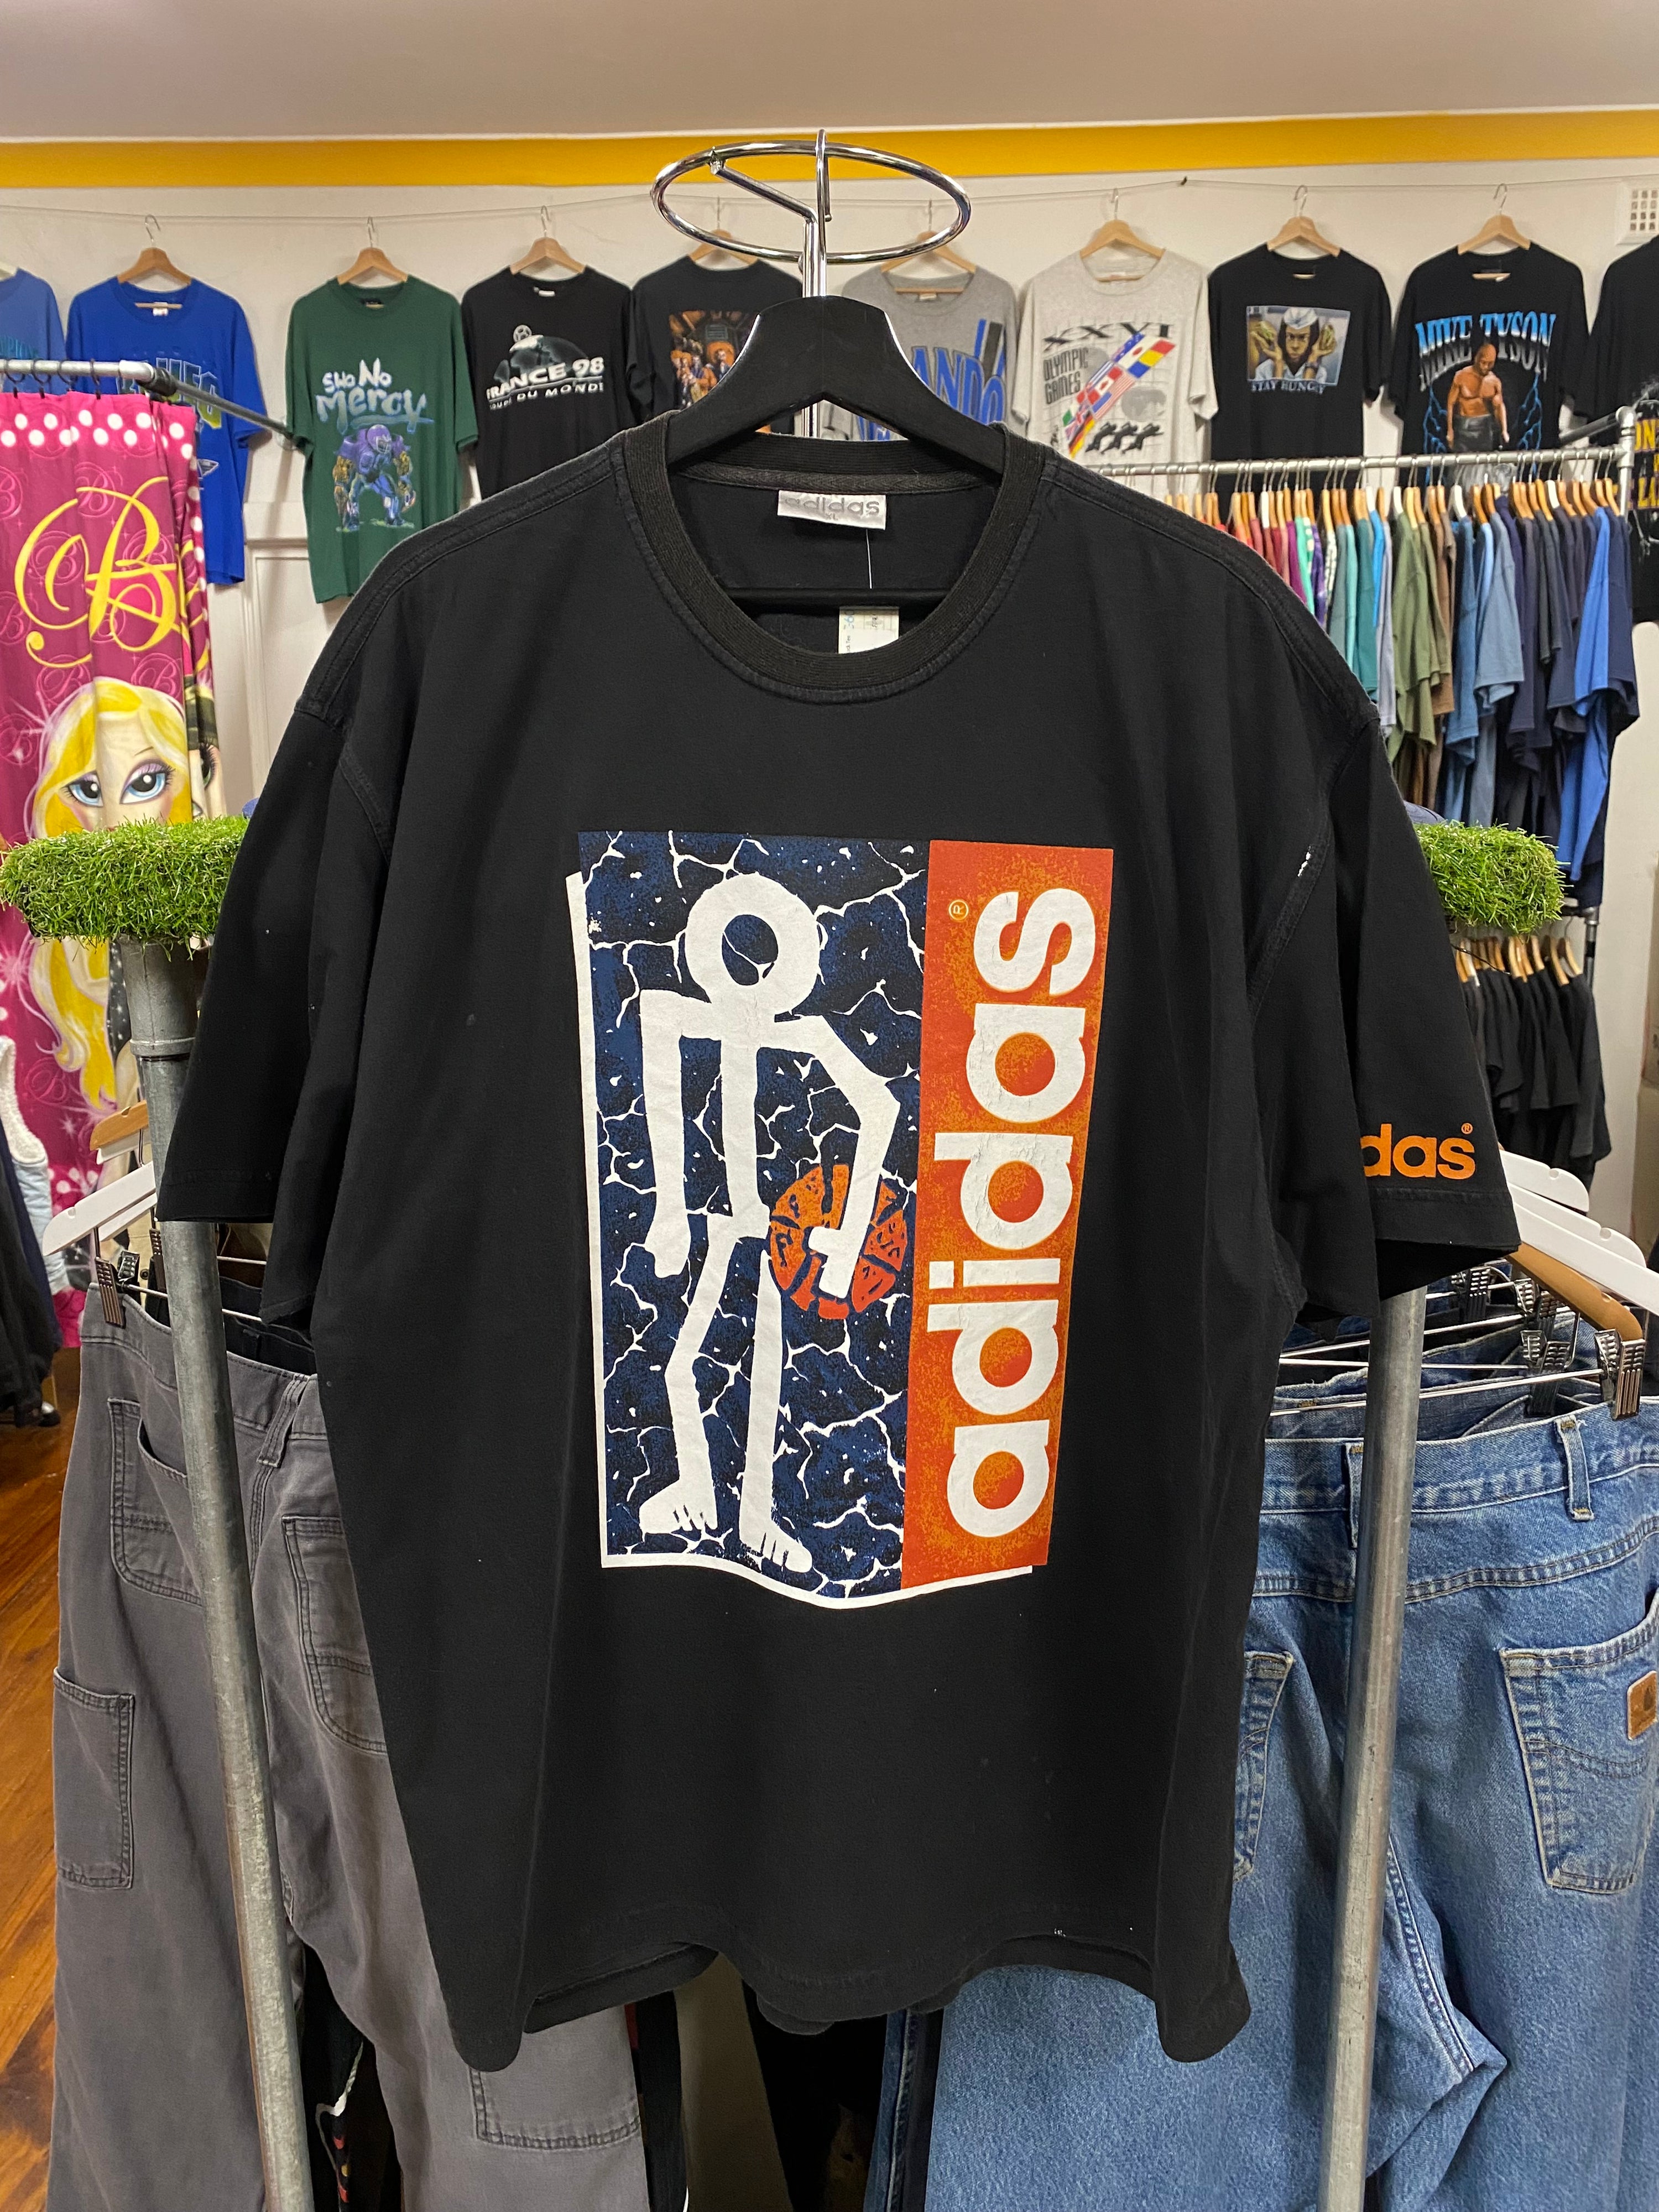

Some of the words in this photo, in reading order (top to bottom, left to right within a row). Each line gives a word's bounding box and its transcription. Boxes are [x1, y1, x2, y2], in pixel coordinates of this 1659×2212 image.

[1479, 311, 1557, 347] TYSON
[572, 357, 604, 378] 98
[1044, 347, 1089, 382] OLYMPIC
[517, 390, 538, 403] DU
[1045, 371, 1081, 405] GAMES
[785, 497, 880, 516] adidas
[825, 512, 838, 520] XL
[927, 887, 1095, 1539] adidas
